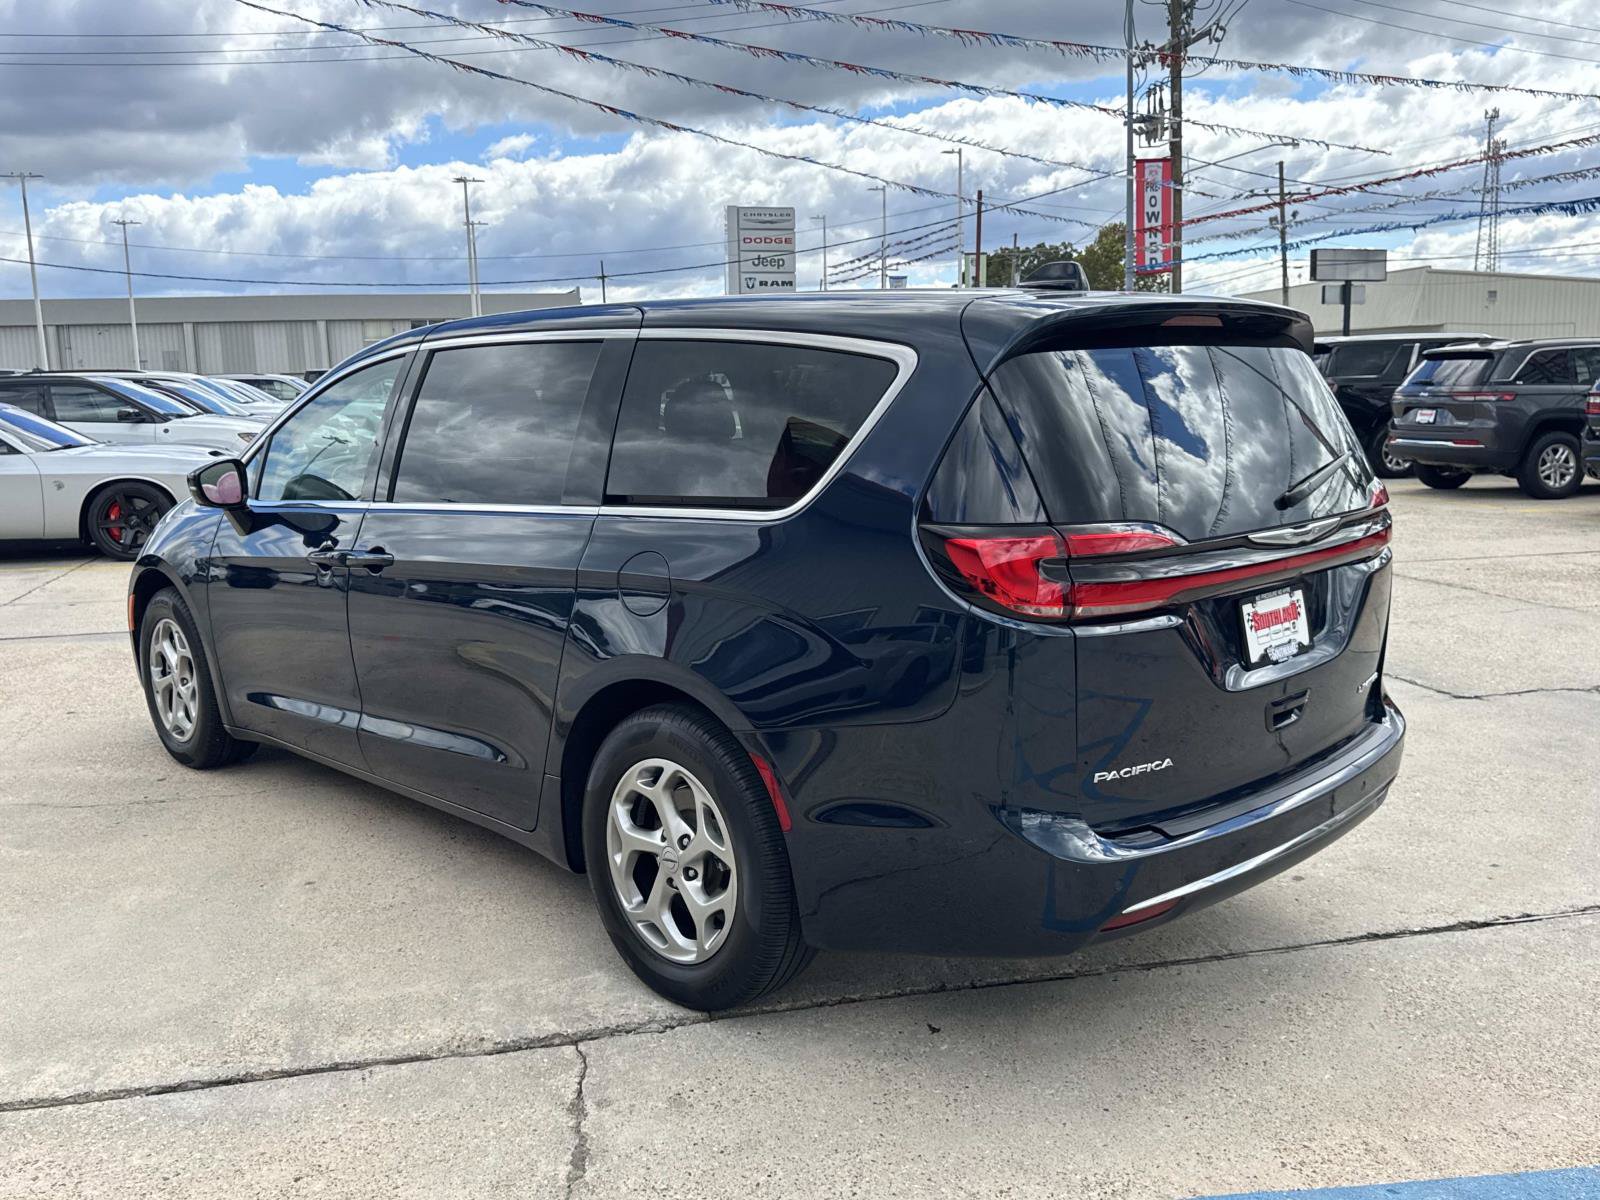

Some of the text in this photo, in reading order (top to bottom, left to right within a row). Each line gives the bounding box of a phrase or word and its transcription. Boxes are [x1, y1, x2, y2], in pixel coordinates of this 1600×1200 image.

[751, 254, 785, 269] Jeep
[1252, 601, 1299, 633] SOUTHLAND
[1093, 758, 1173, 783] PACIFICA
